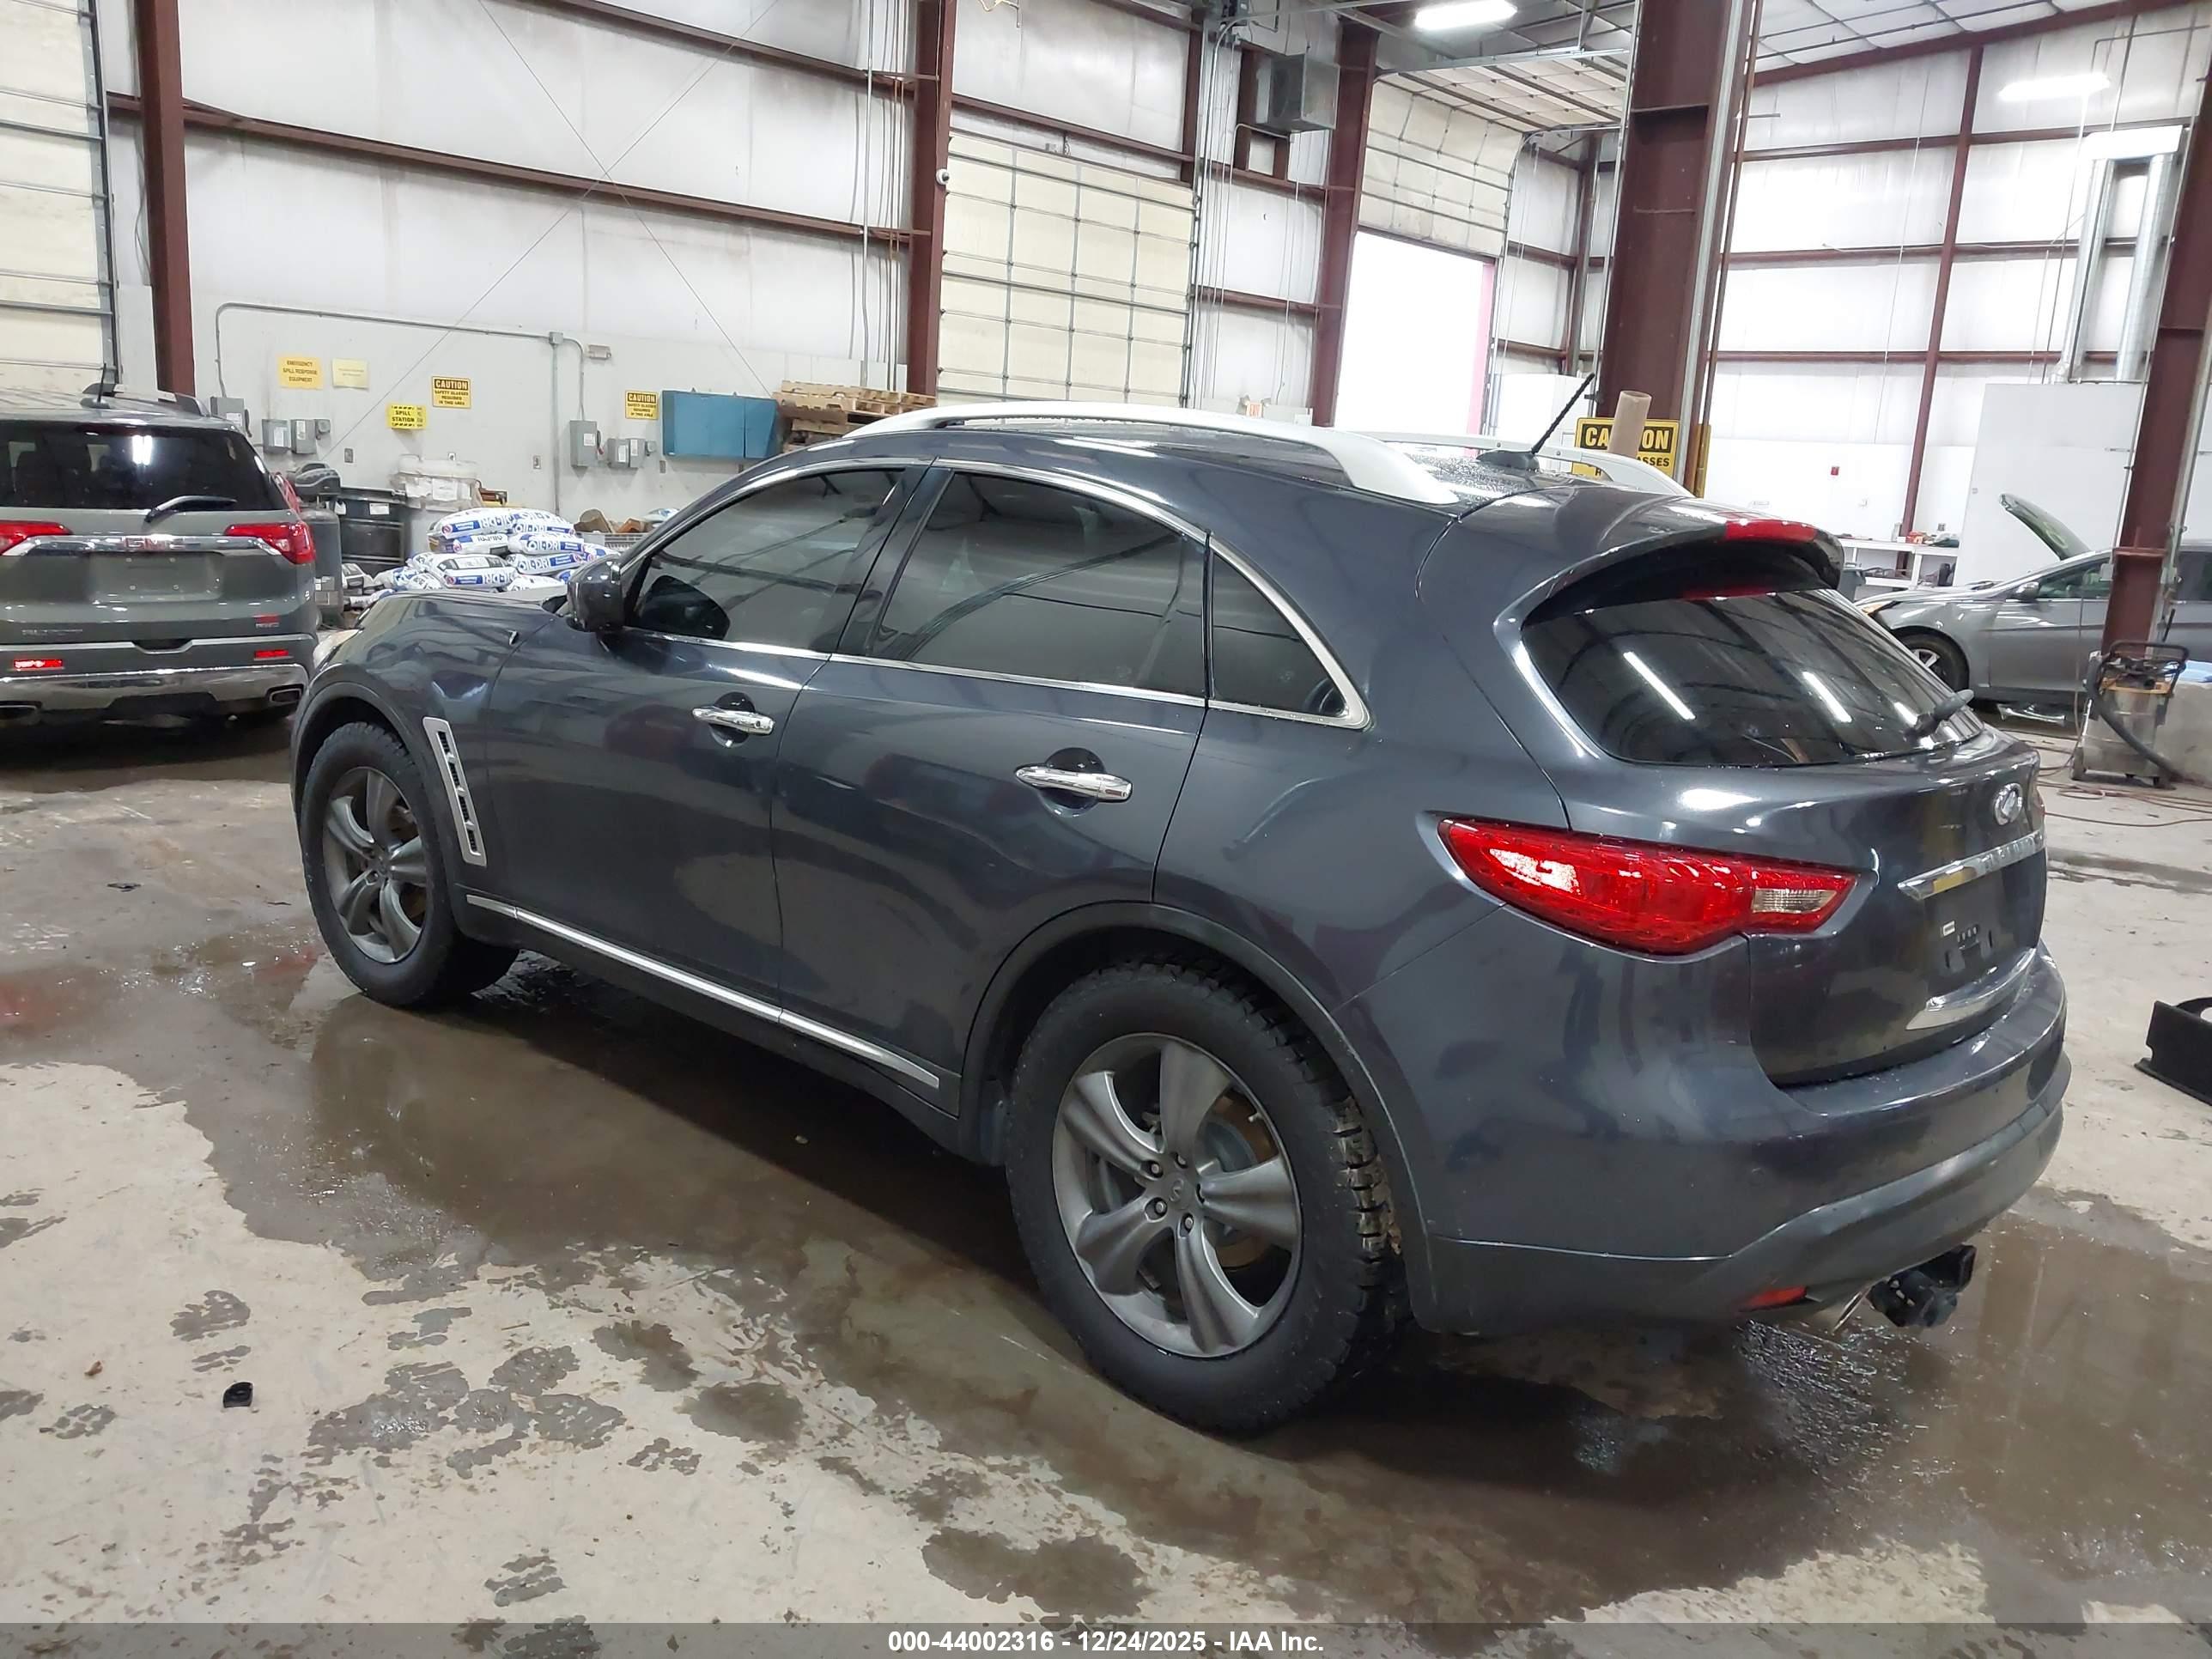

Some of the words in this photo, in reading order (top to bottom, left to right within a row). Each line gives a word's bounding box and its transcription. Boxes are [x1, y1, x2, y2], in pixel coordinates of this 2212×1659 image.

[435, 380, 467, 390] CAUTION
[629, 393, 655, 402] CAUTION
[1585, 428, 1669, 450] CAON
